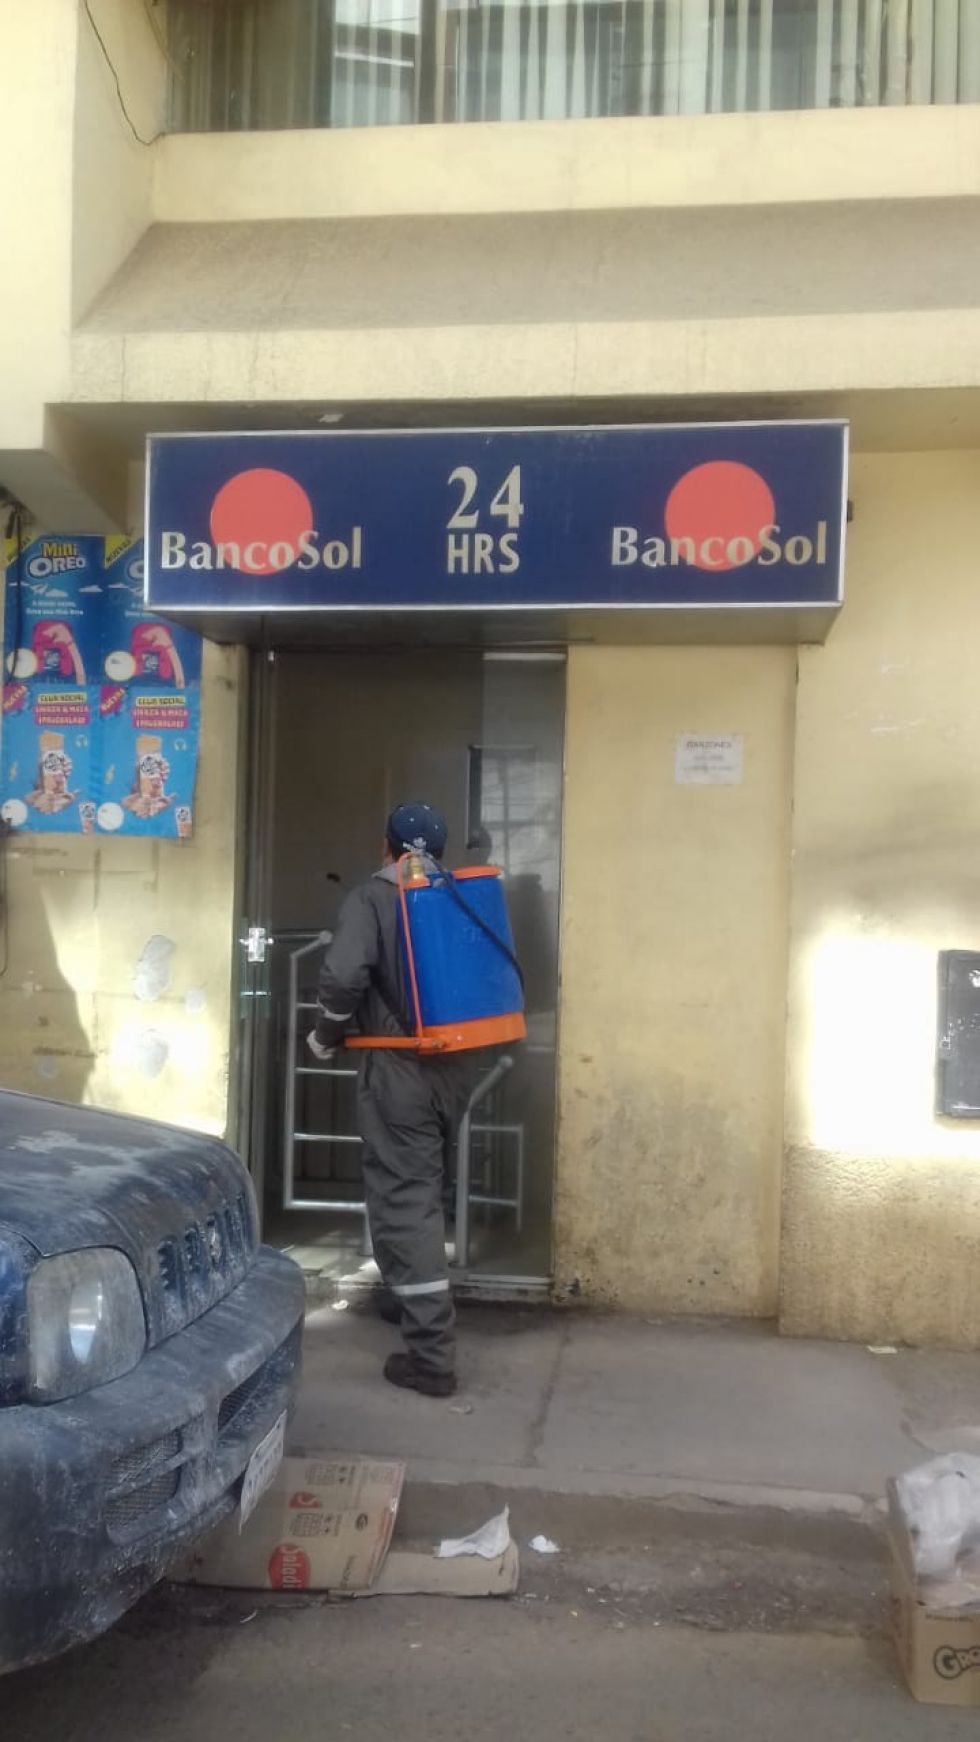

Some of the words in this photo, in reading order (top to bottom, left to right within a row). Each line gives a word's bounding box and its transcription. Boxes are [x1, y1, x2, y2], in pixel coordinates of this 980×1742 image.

[447, 465, 524, 528] 24
[161, 526, 361, 571] BancoSol
[447, 534, 519, 574] HRS
[611, 520, 827, 568] BancoSol
[28, 556, 87, 578] OREO
